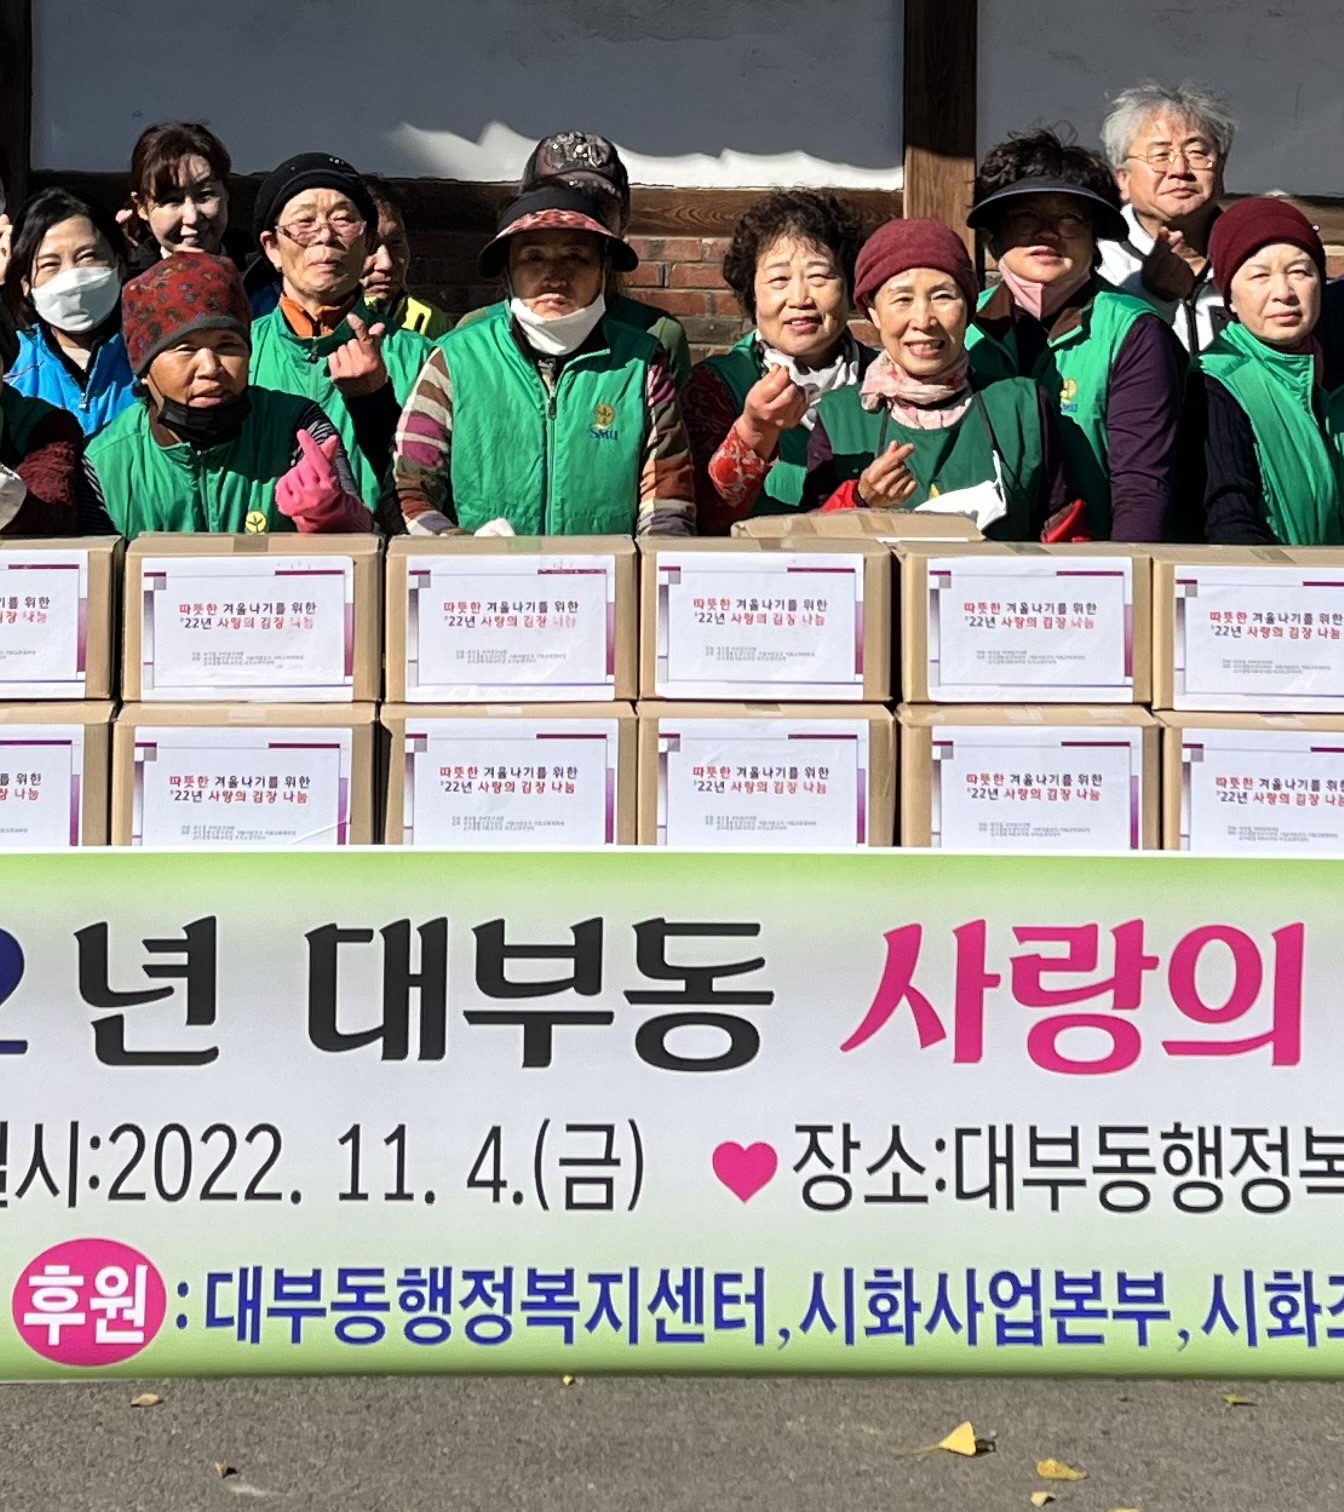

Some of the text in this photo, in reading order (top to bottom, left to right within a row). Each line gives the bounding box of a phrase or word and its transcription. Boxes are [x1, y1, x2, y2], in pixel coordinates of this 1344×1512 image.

[440, 766, 578, 779] 따뜻한 겨울나기를 위한
[693, 766, 829, 780] 따뜻한 겨울나기를 위한
[16, 773, 41, 786] 위한
[170, 776, 310, 789] 따뜻한 겨울나기를 위한
[966, 774, 1102, 787] 따뜻한 겨울나기를 위한
[1216, 777, 1253, 790] 따뜻한
[1259, 777, 1320, 792] 겨울나기를
[15, 788, 39, 800] 나눔
[478, 782, 515, 794] 사랑의
[522, 781, 545, 794] 김장
[552, 782, 574, 793] 나눔
[731, 782, 767, 793] 사랑의
[775, 782, 797, 795] 김장
[804, 782, 826, 794] 나눔
[208, 791, 246, 803] 사랑의
[253, 791, 277, 803] 김장
[283, 791, 307, 803] 나눔
[1004, 789, 1041, 800] 사랑의
[1048, 789, 1071, 801] 김장
[1077, 789, 1100, 801] 나눔
[1253, 792, 1289, 805] 사랑의
[1297, 793, 1319, 806] 김장
[73, 915, 219, 1066] 년
[304, 916, 775, 1072] 대부동
[839, 918, 1305, 1075] 사랑의
[338, 1123, 435, 1204] 11.
[466, 1118, 644, 1211] 4.(금)
[22, 1263, 149, 1346] 후원
